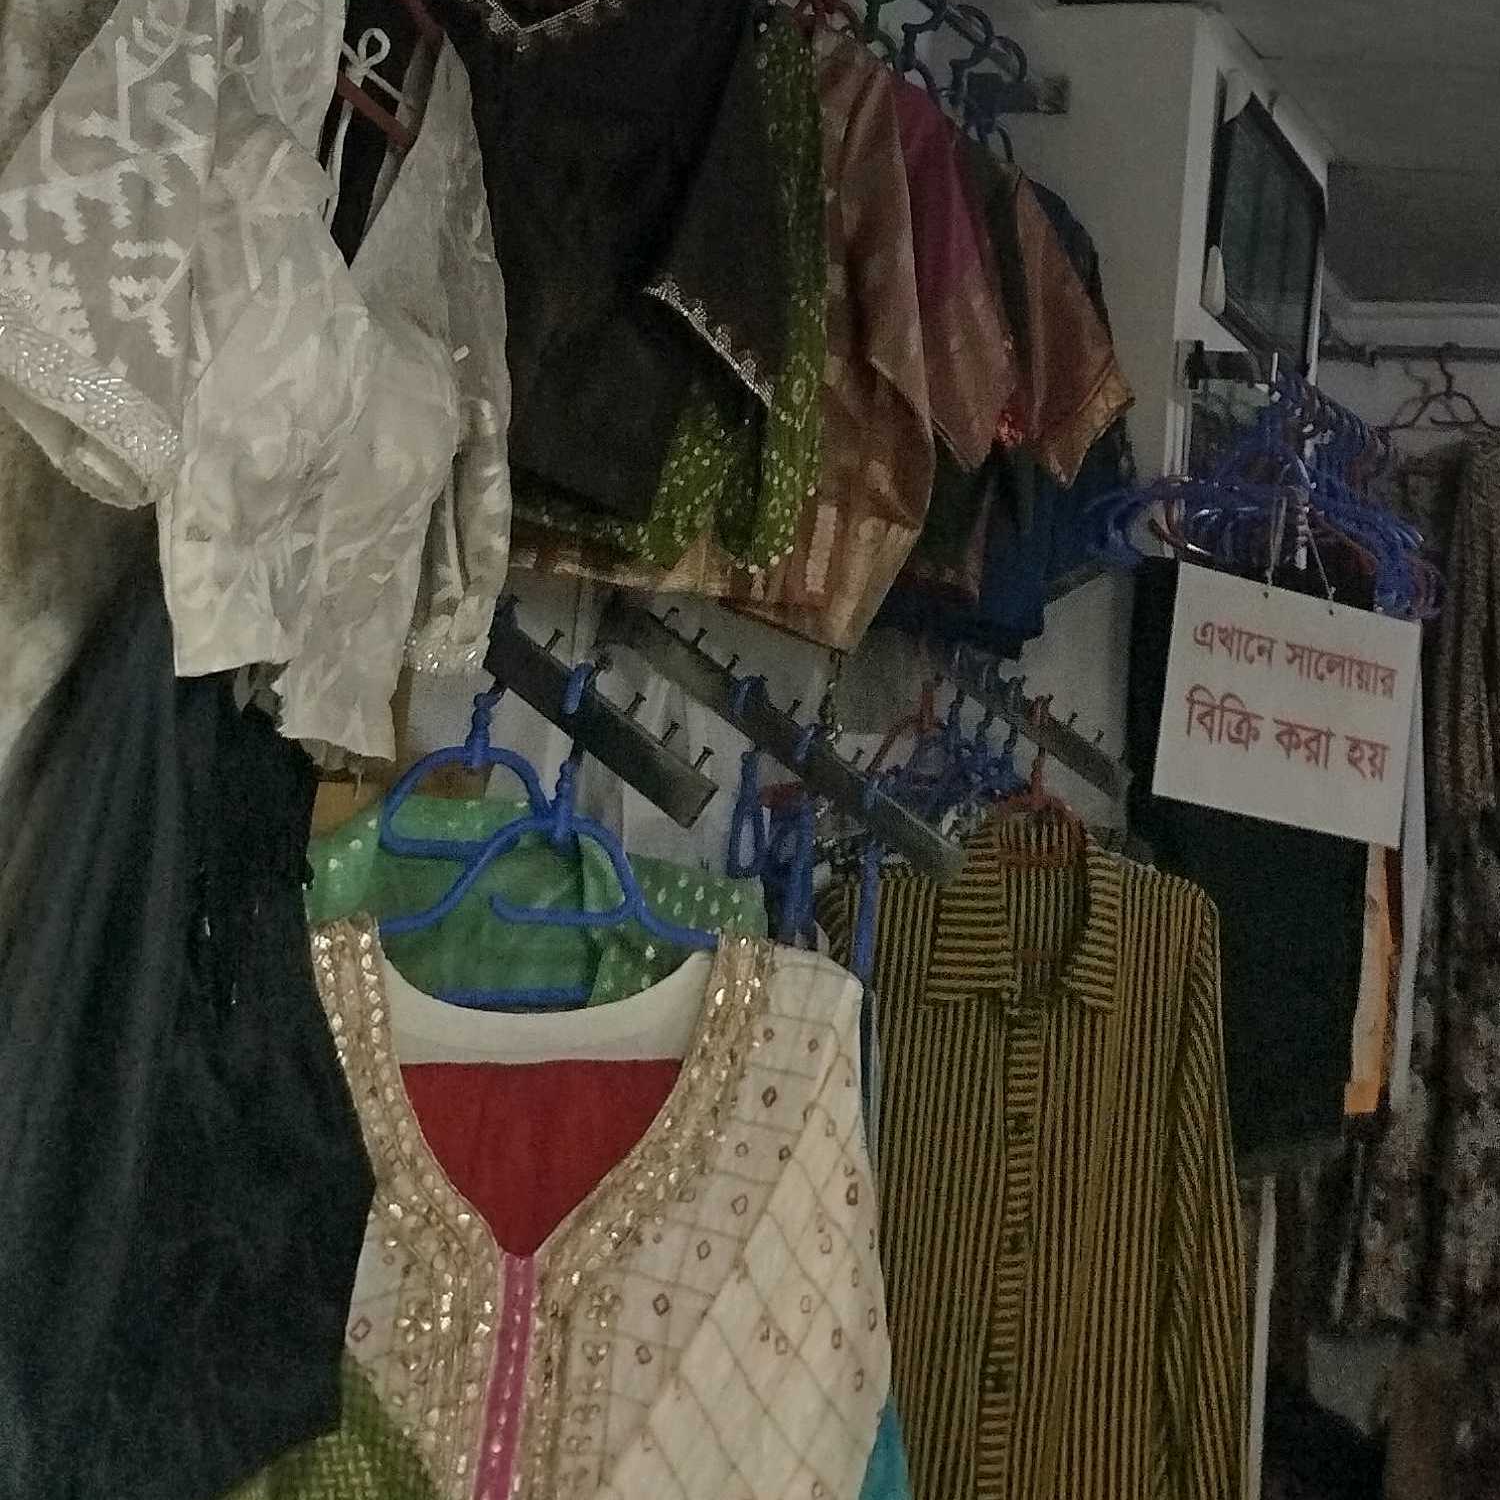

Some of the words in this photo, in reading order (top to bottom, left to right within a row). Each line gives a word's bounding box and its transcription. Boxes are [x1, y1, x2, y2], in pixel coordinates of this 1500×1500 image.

[1194, 621, 1277, 668] এখানে
[1286, 641, 1398, 697] সালোয়ার
[1186, 684, 1265, 751] বিক্রি
[1272, 717, 1336, 769] করা
[1344, 735, 1391, 781] হয়
